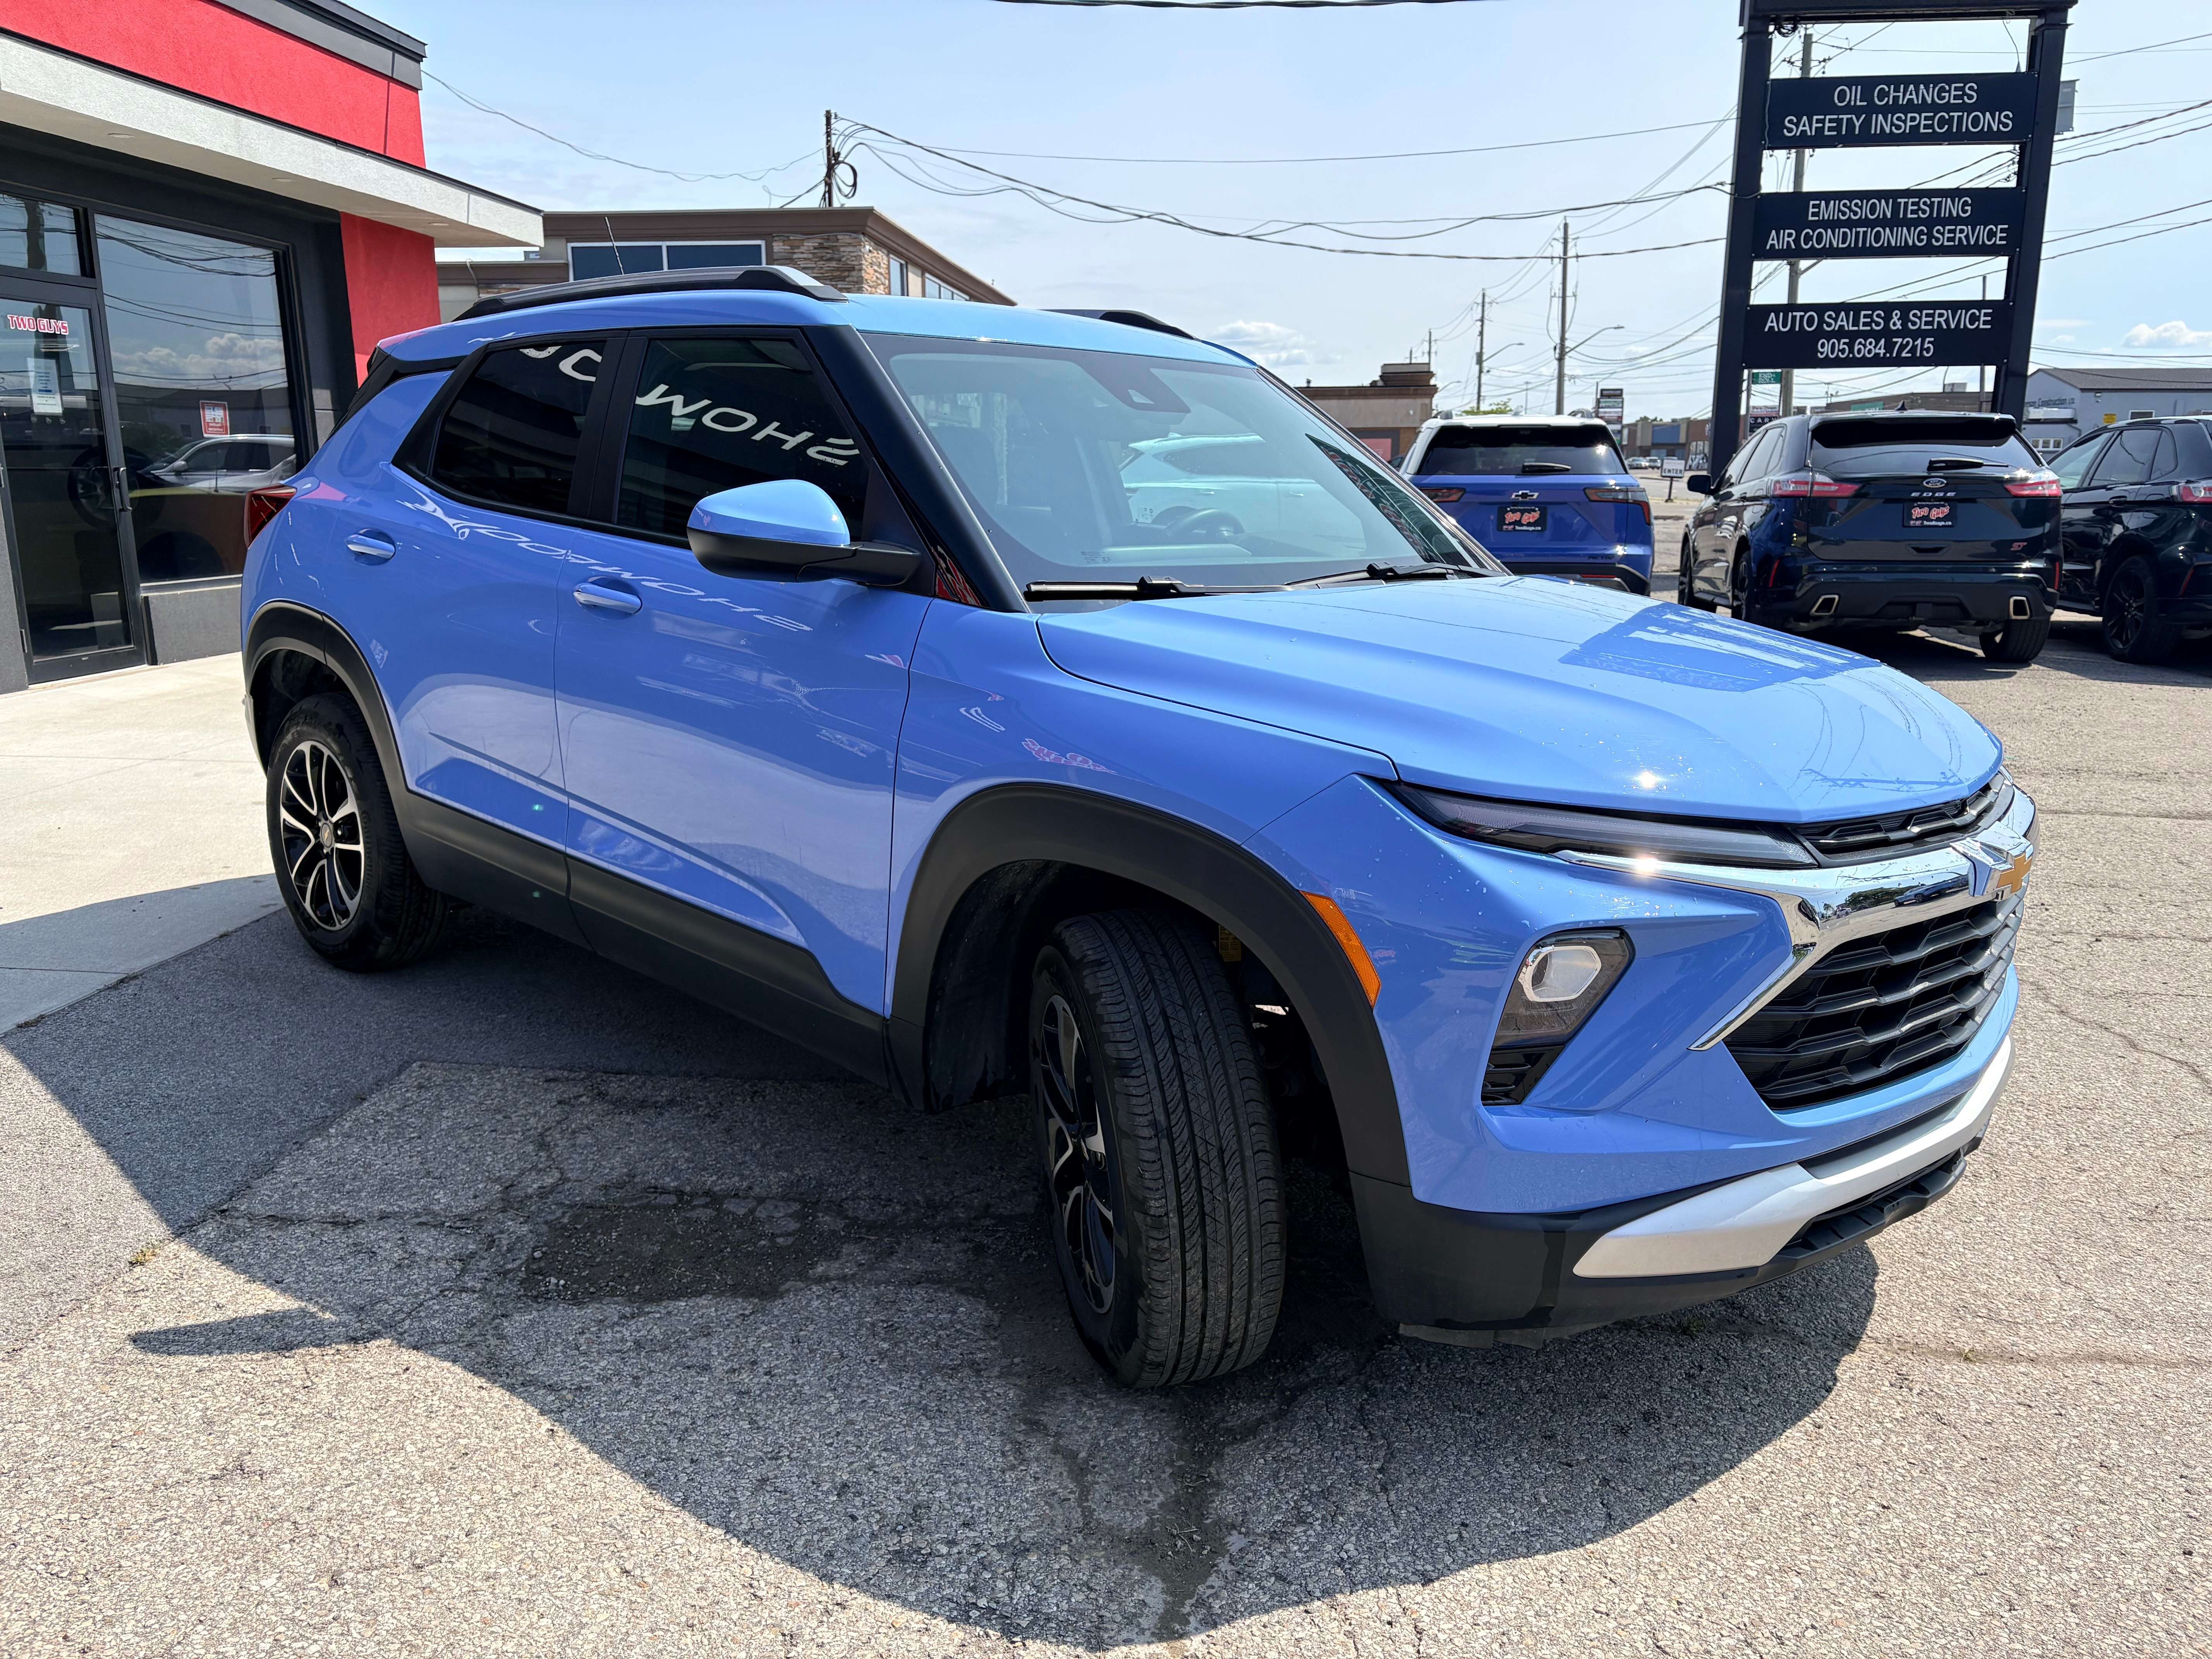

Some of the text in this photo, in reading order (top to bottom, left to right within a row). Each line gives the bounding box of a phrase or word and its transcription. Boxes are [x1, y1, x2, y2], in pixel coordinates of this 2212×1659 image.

[1834, 83, 1977, 106] OIL CHANGES
[1783, 111, 2013, 136] SAFETY INSPECTIONS
[1808, 197, 1972, 220] EMISSION TESTING
[1766, 225, 2008, 249] AIR CONDITIONING SERVICE
[7, 314, 69, 335] TWO GUYS
[1764, 309, 1993, 331] AUTO SALES & SERVICE
[1817, 337, 1934, 358] 905.684.7215
